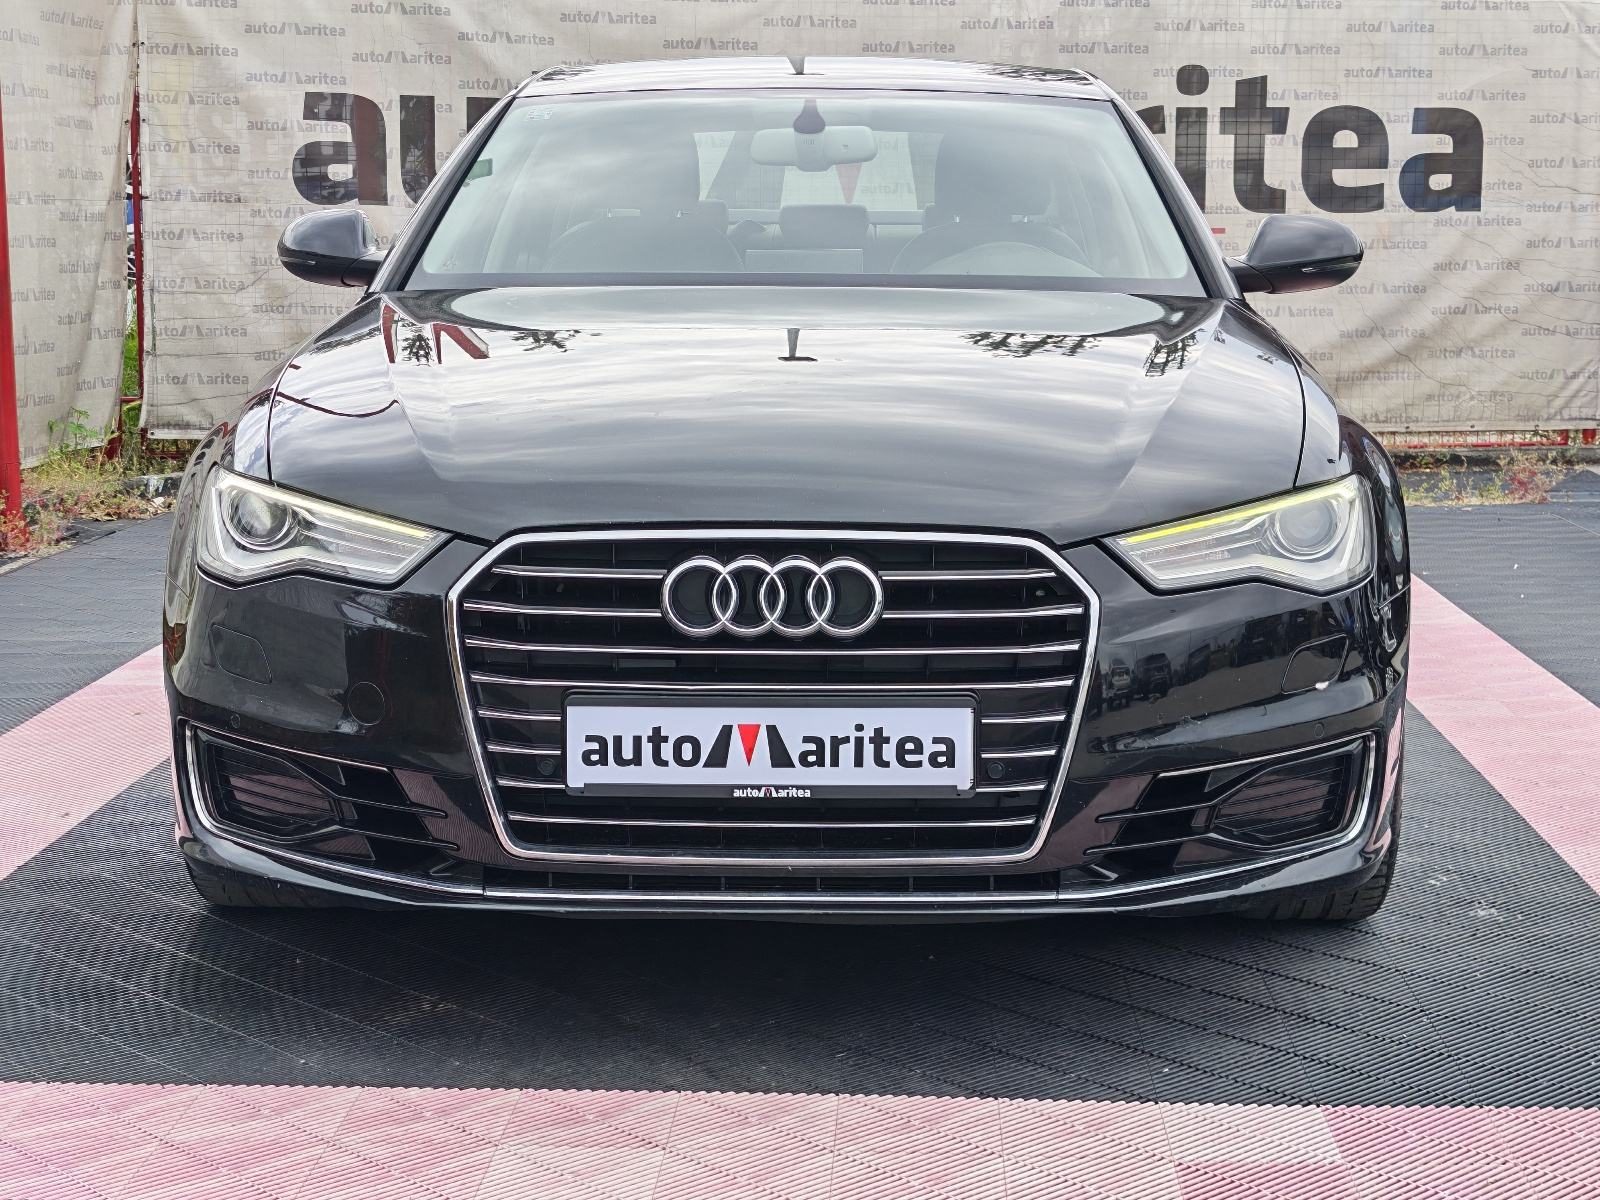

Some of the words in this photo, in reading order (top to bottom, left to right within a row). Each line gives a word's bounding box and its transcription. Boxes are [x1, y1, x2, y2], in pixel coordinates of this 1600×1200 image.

[350, 3, 451, 17] autoMaritea
[560, 11, 656, 25] autoMaritea
[763, 15, 857, 29] autoMaritea
[960, 17, 1054, 31] autoMaritea
[244, 22, 346, 37] autoMaritea
[1153, 19, 1245, 32] autoMaritea
[1345, 20, 1435, 34] autoMaritea
[457, 31, 554, 46] autoMaritea
[662, 36, 758, 51] autoMaritea
[861, 40, 956, 54] autoMaritea
[1058, 42, 1149, 55] autoMaritea
[1251, 43, 1341, 56] autoMaritea
[1438, 44, 1528, 57] autoMaritea
[352, 51, 452, 65] autoMaritea
[245, 71, 347, 86] autoMaritea
[1344, 66, 1433, 79] autoMaritea
[1437, 89, 1526, 102] autoMaritea
[1433, 215, 1522, 229] autoMaritea
[1433, 259, 1520, 272] autoMaritea
[1338, 282, 1427, 295] autoMaritea
[1431, 304, 1519, 316] autoMaritea
[581, 723, 956, 768] autoMaritea
[732, 786, 811, 798] autoMaritea
